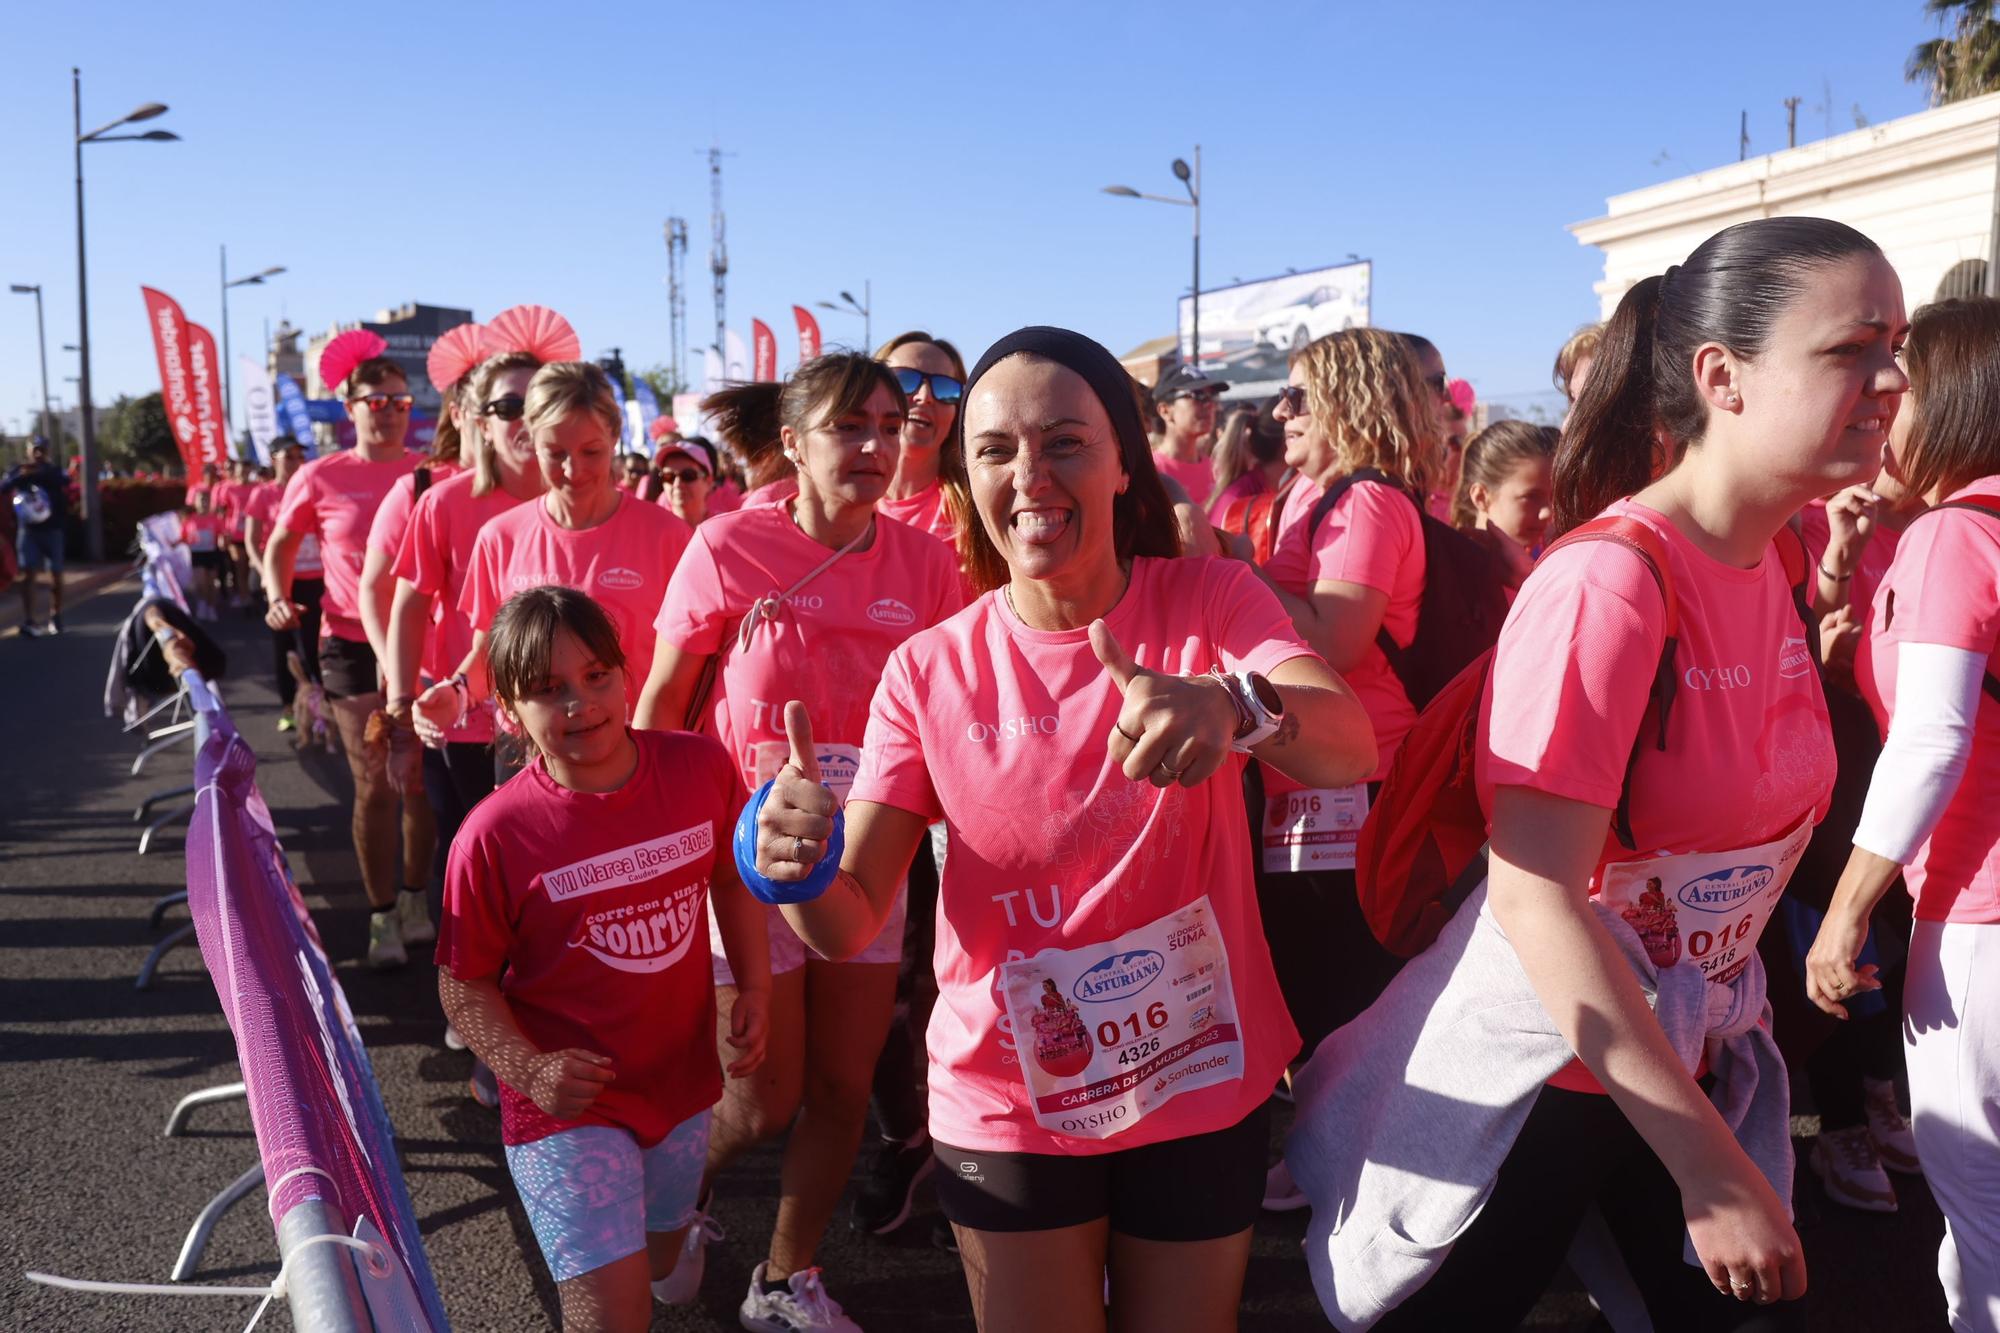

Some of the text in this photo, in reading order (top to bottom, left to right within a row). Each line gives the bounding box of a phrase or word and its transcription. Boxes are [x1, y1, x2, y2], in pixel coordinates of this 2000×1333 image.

[512, 573, 560, 588] OYSHO
[967, 715, 1061, 742] OYSHO
[1290, 796, 1321, 814] 016
[550, 827, 712, 895] VII Marea Rosa 2022
[628, 868, 659, 883] Caudete
[1686, 875, 1766, 903] ASTURIANA
[586, 883, 699, 925] corre con una
[992, 884, 1062, 928] TU
[589, 892, 698, 956] sonrisa
[1167, 921, 1204, 942] TU DORSAL
[1688, 914, 1753, 958] 016
[1169, 927, 1207, 951] SUMA
[1082, 961, 1160, 998] ASTURIANA
[1094, 968, 1125, 981] CENTRAL
[1097, 1002, 1169, 1047] 016
[1118, 1037, 1160, 1066] 4326
[1061, 1029, 1219, 1106] CARRERA DE LA MUJER 2023
[1168, 1054, 1230, 1085] Santander
[1062, 1105, 1127, 1131] OYSHO
